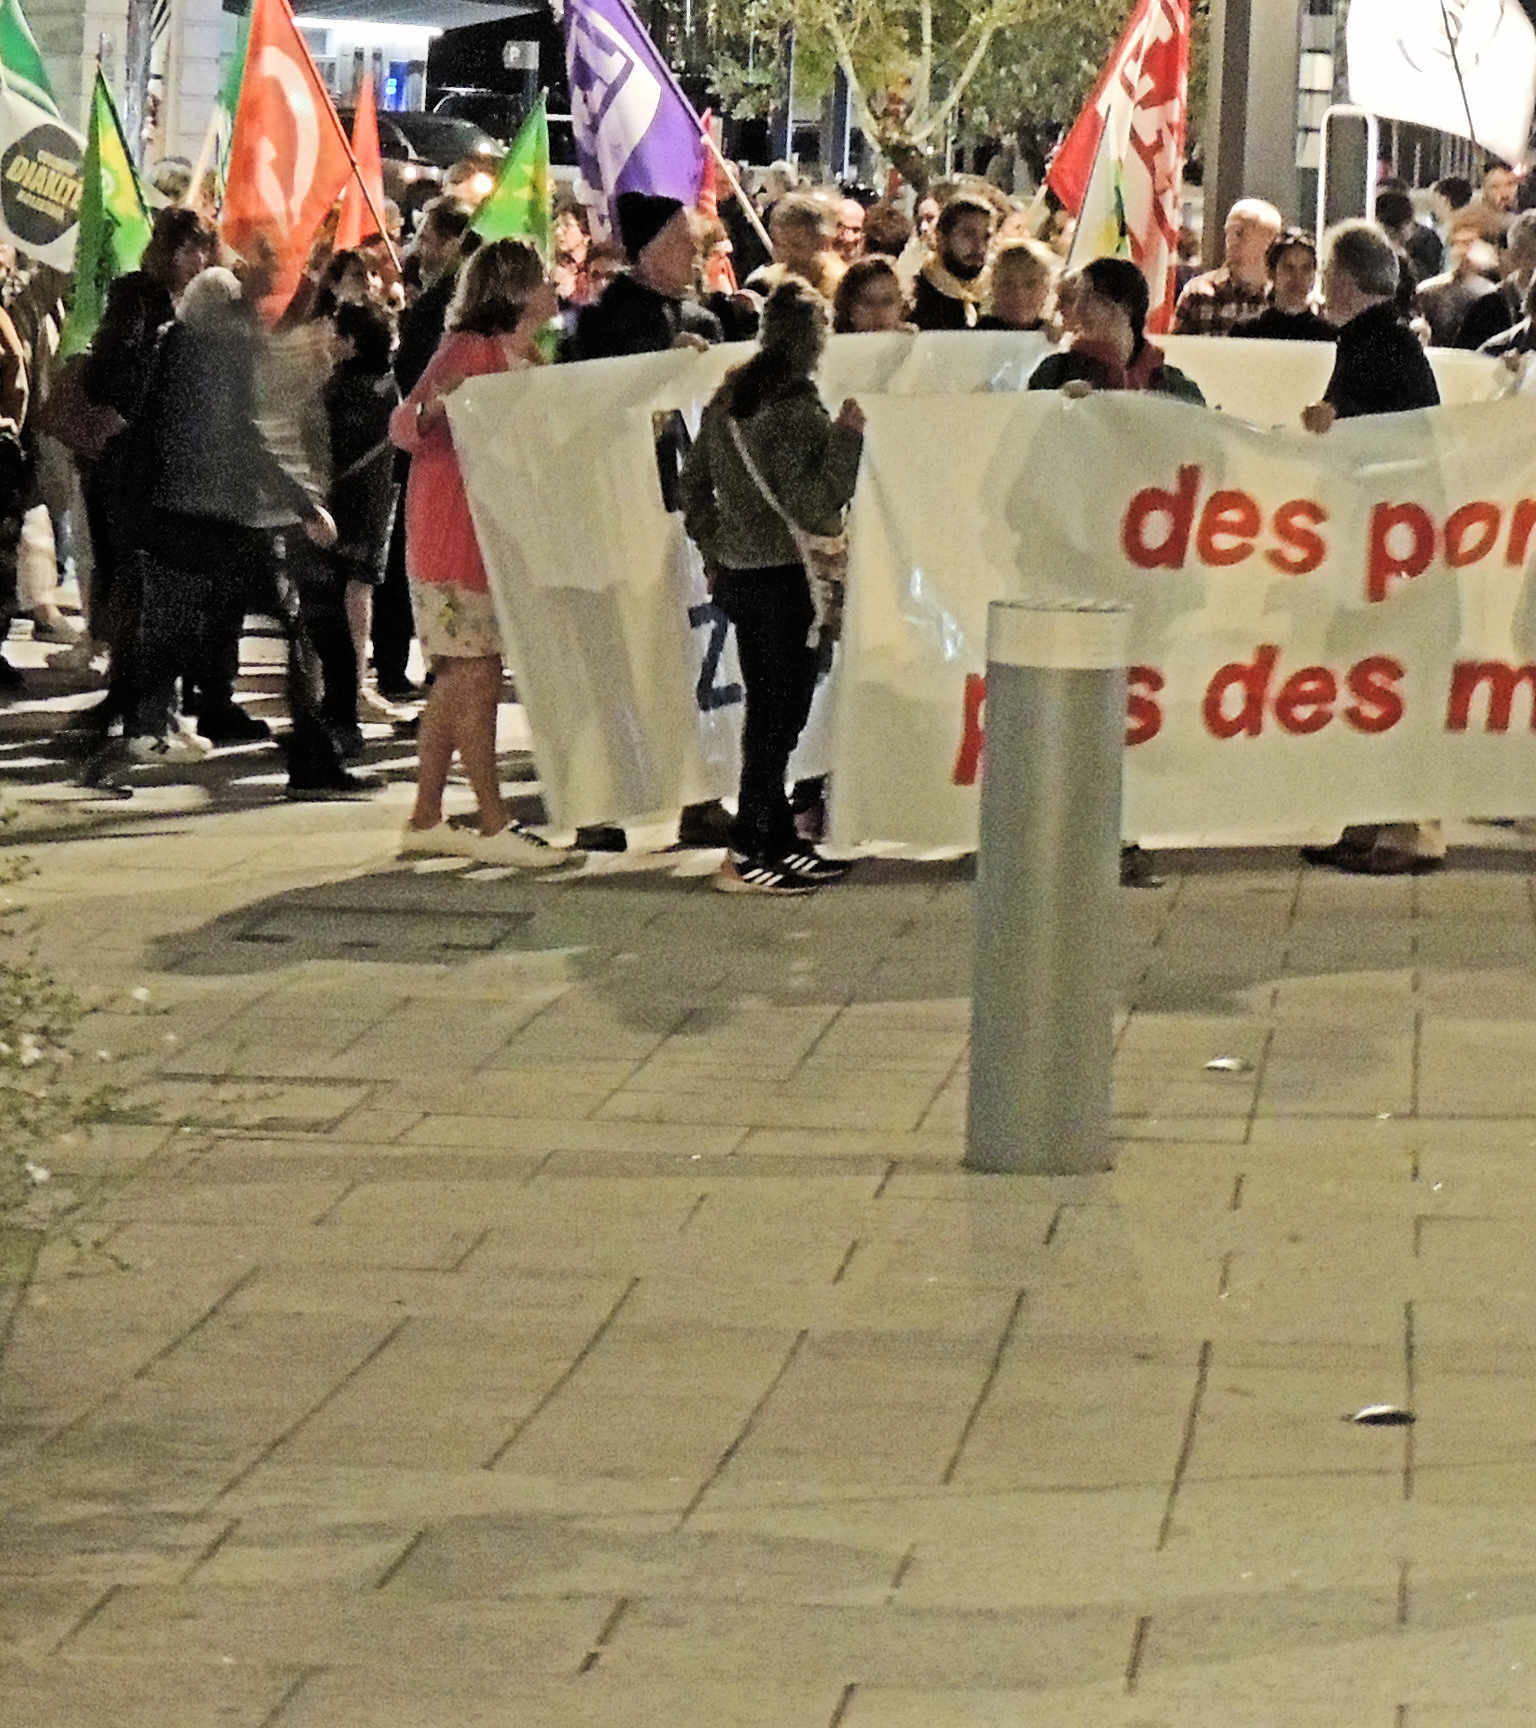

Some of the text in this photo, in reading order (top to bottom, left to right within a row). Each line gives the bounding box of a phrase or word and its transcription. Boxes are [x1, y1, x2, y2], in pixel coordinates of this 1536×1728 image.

[1119, 462, 1332, 575] des
[950, 665, 1165, 786] ps
[1200, 642, 1406, 740] des
